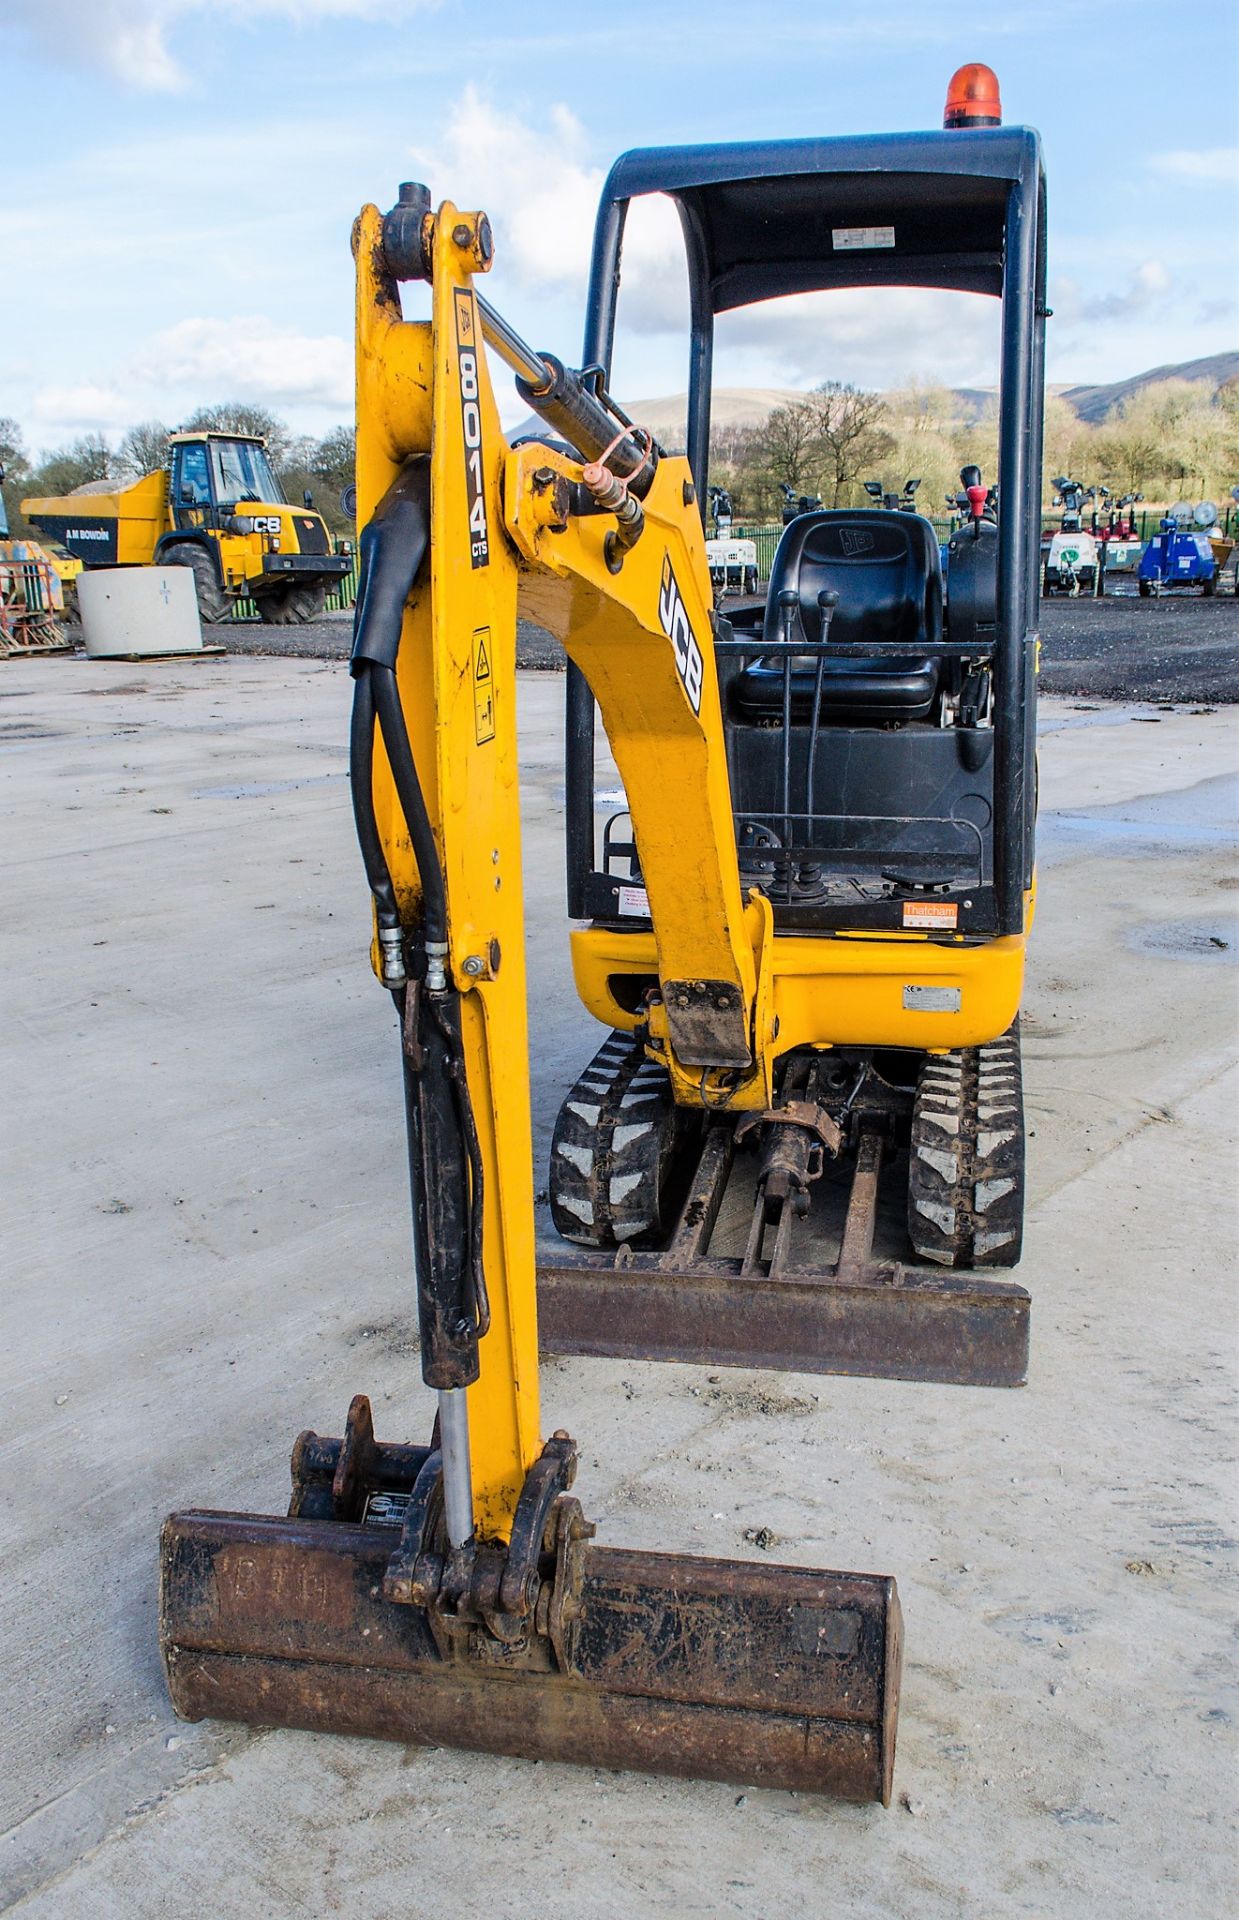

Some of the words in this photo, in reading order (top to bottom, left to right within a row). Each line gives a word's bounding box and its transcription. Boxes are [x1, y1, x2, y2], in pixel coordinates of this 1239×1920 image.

[460, 353, 487, 539] 8014
[471, 541, 488, 557] CTS
[660, 577, 702, 712] JCB
[907, 904, 955, 916] Thatcham
